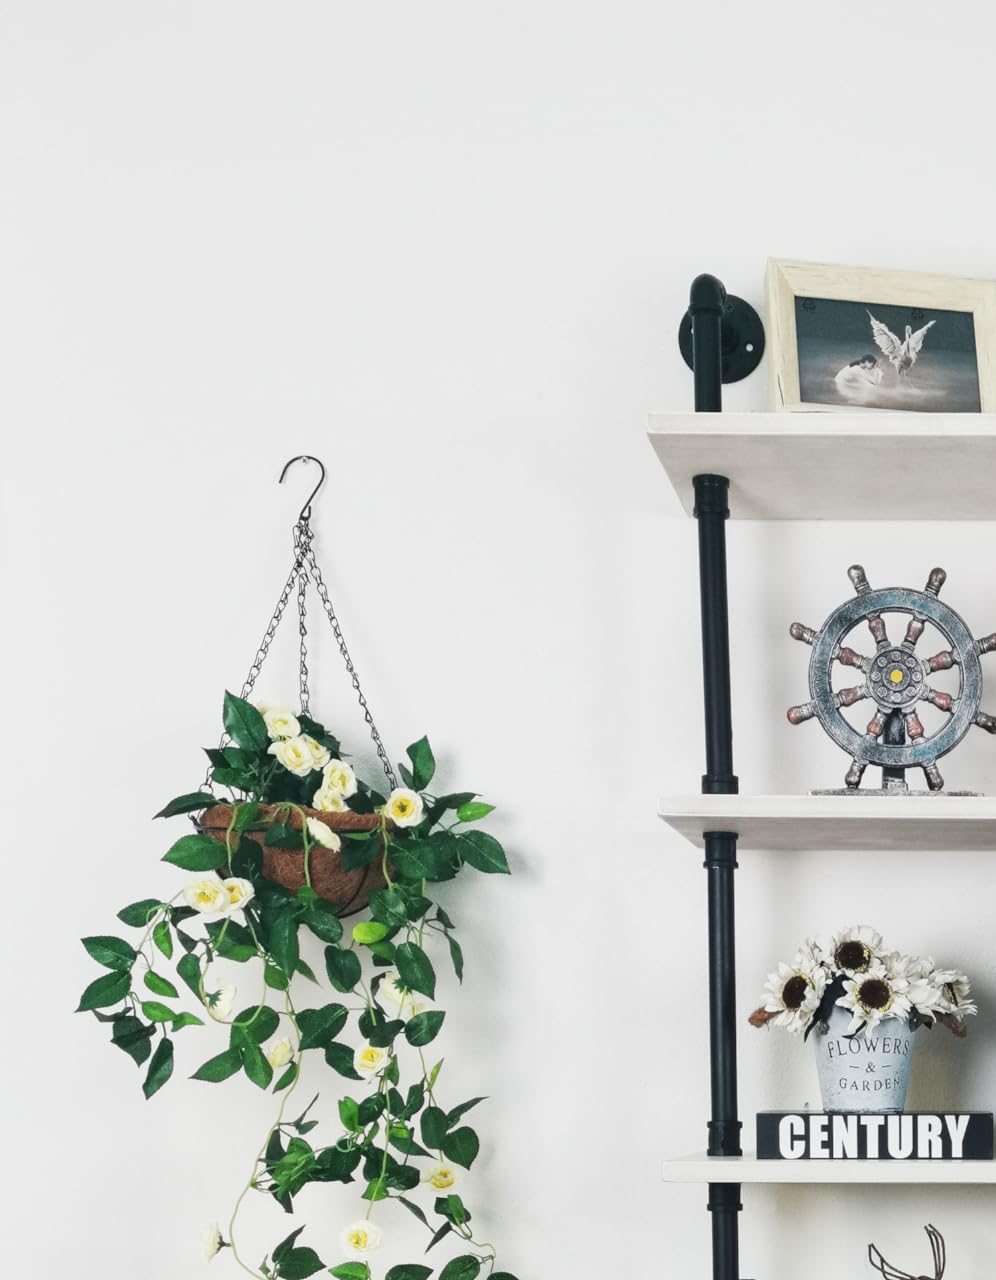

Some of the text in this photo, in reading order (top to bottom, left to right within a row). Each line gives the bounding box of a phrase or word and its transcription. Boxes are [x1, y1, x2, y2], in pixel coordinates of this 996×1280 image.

[827, 1037, 910, 1058] FLOWERS
[865, 1061, 875, 1073] &
[839, 1075, 901, 1091] GARDEN
[778, 1114, 971, 1159] CENTURY
